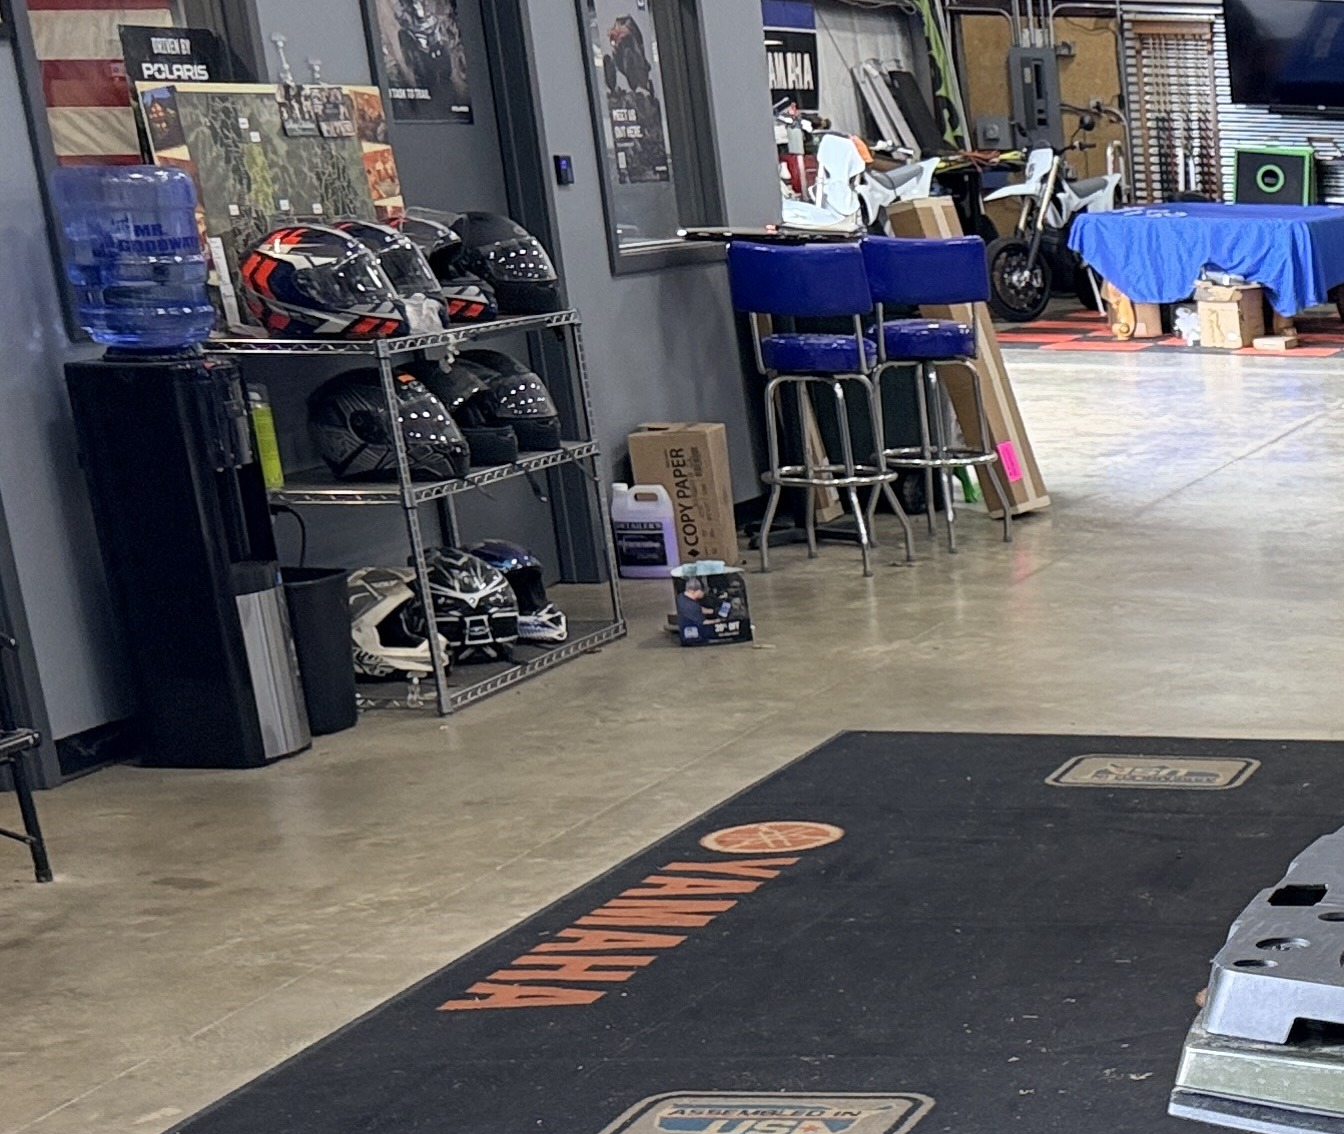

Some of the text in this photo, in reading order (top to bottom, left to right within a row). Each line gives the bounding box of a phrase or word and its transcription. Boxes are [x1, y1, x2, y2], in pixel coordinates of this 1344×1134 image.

[141, 63, 209, 80] POLARIS
[767, 52, 815, 91] AMAHA
[669, 447, 699, 547] COPY PAPER
[436, 857, 801, 1010] YAMAHA
[667, 1108, 826, 1117] ASSEMBLED
